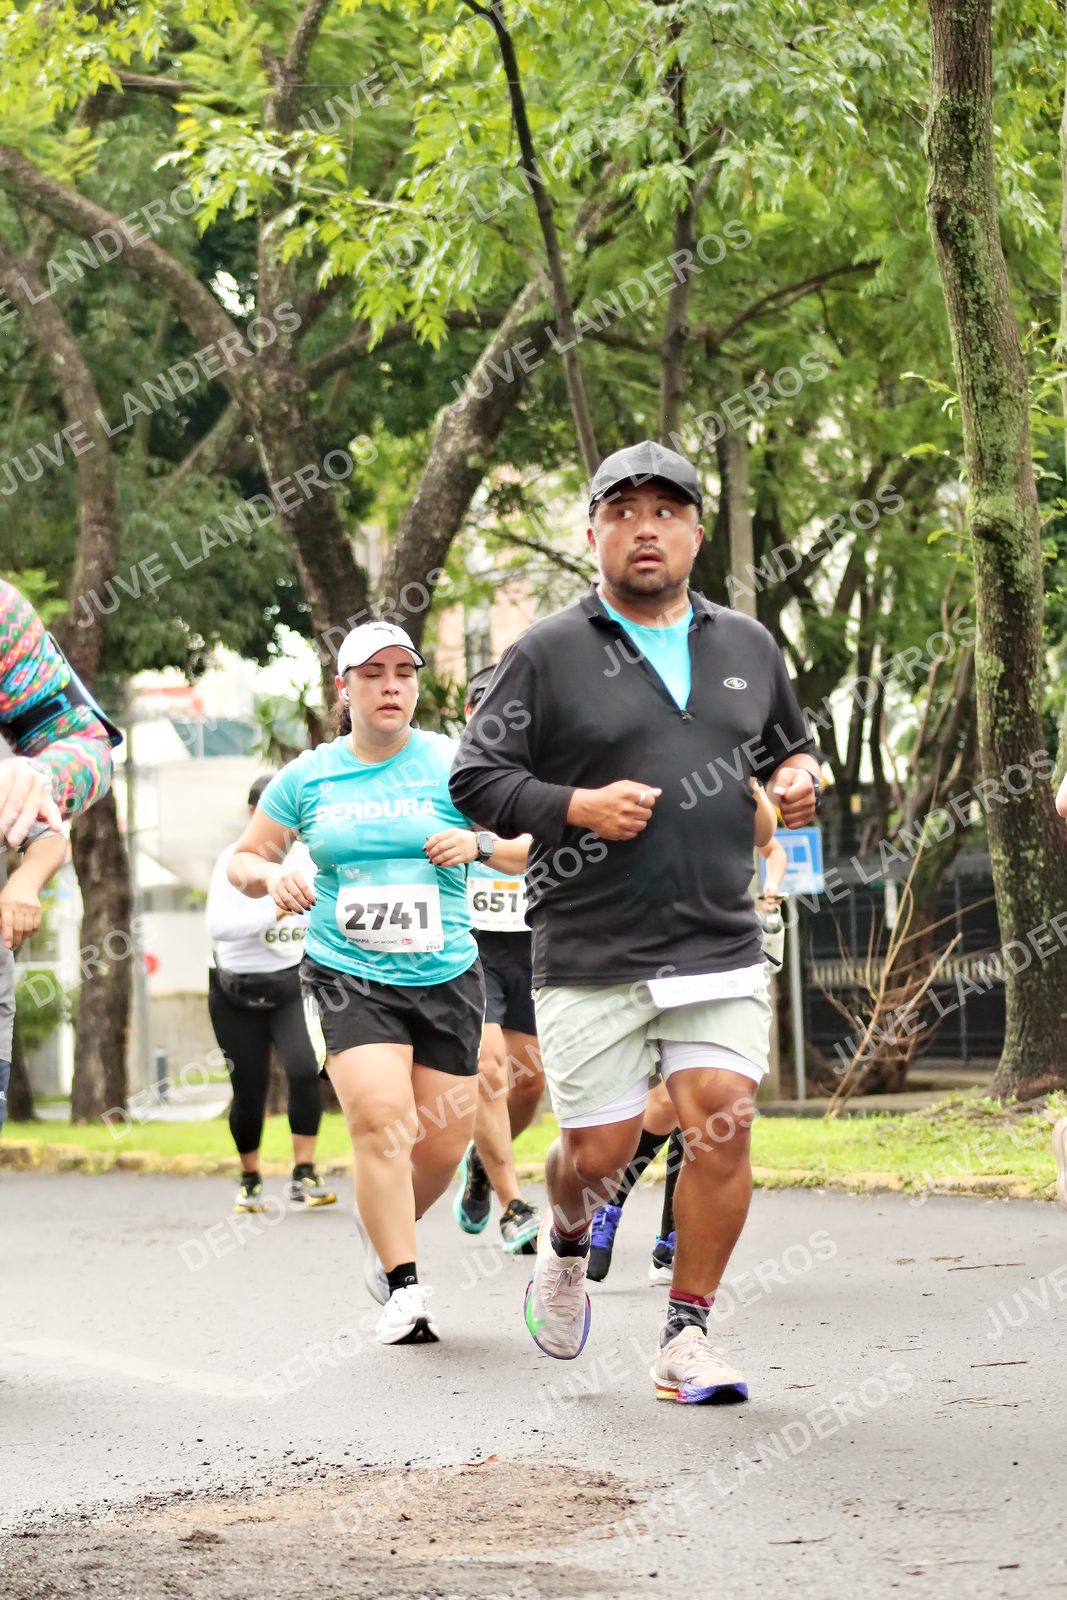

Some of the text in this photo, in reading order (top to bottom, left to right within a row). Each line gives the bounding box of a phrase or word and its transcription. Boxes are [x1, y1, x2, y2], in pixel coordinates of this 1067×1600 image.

[316, 797, 437, 824] PERDURA
[344, 902, 428, 930] 2741
[265, 927, 306, 943] 666
